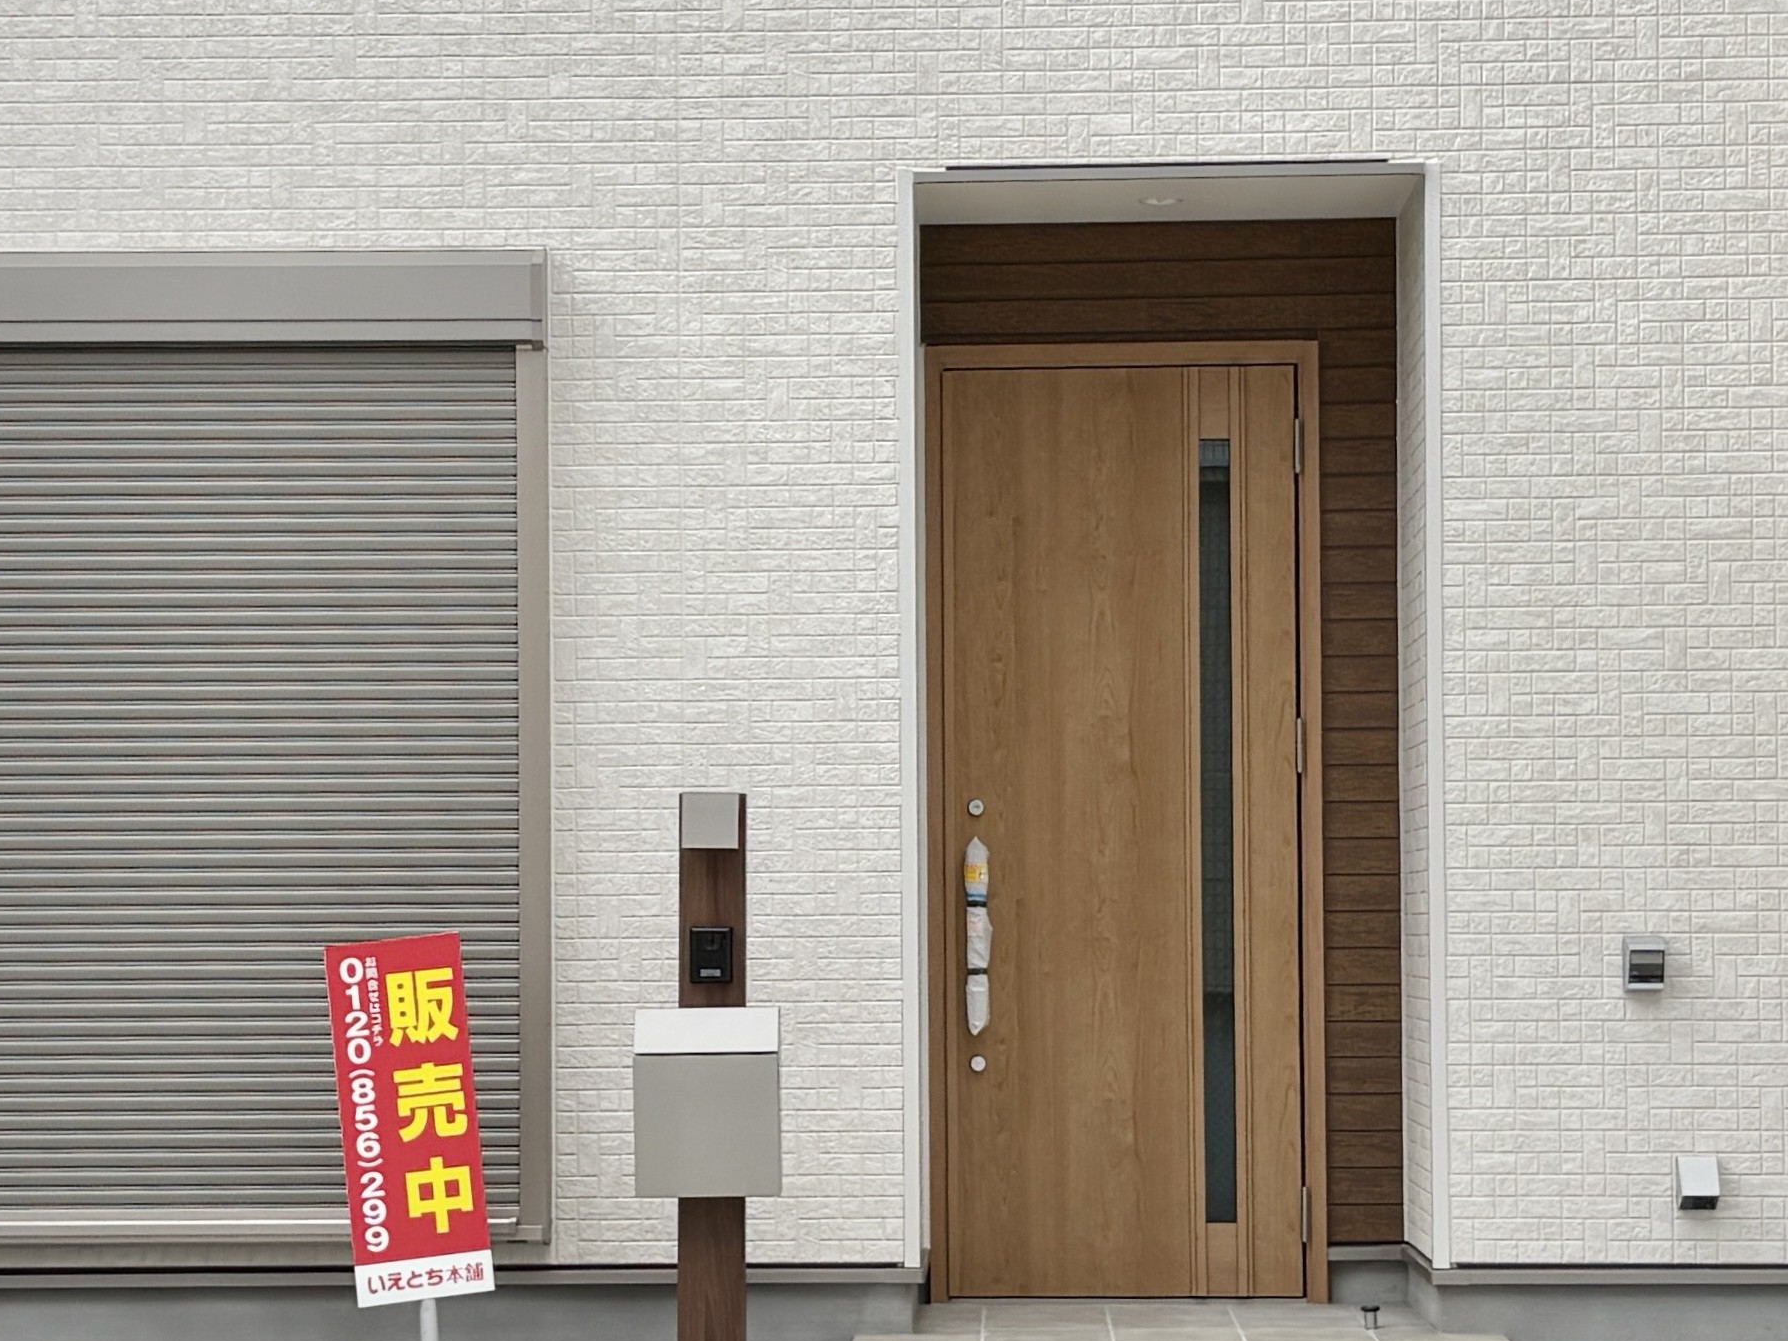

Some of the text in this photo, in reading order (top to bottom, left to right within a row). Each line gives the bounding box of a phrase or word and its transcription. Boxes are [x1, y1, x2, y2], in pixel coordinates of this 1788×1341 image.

[339, 957, 390, 1254] 0120(856)299
[385, 967, 475, 1233] 販売中
[367, 1262, 484, 1295] いえとち本舗
